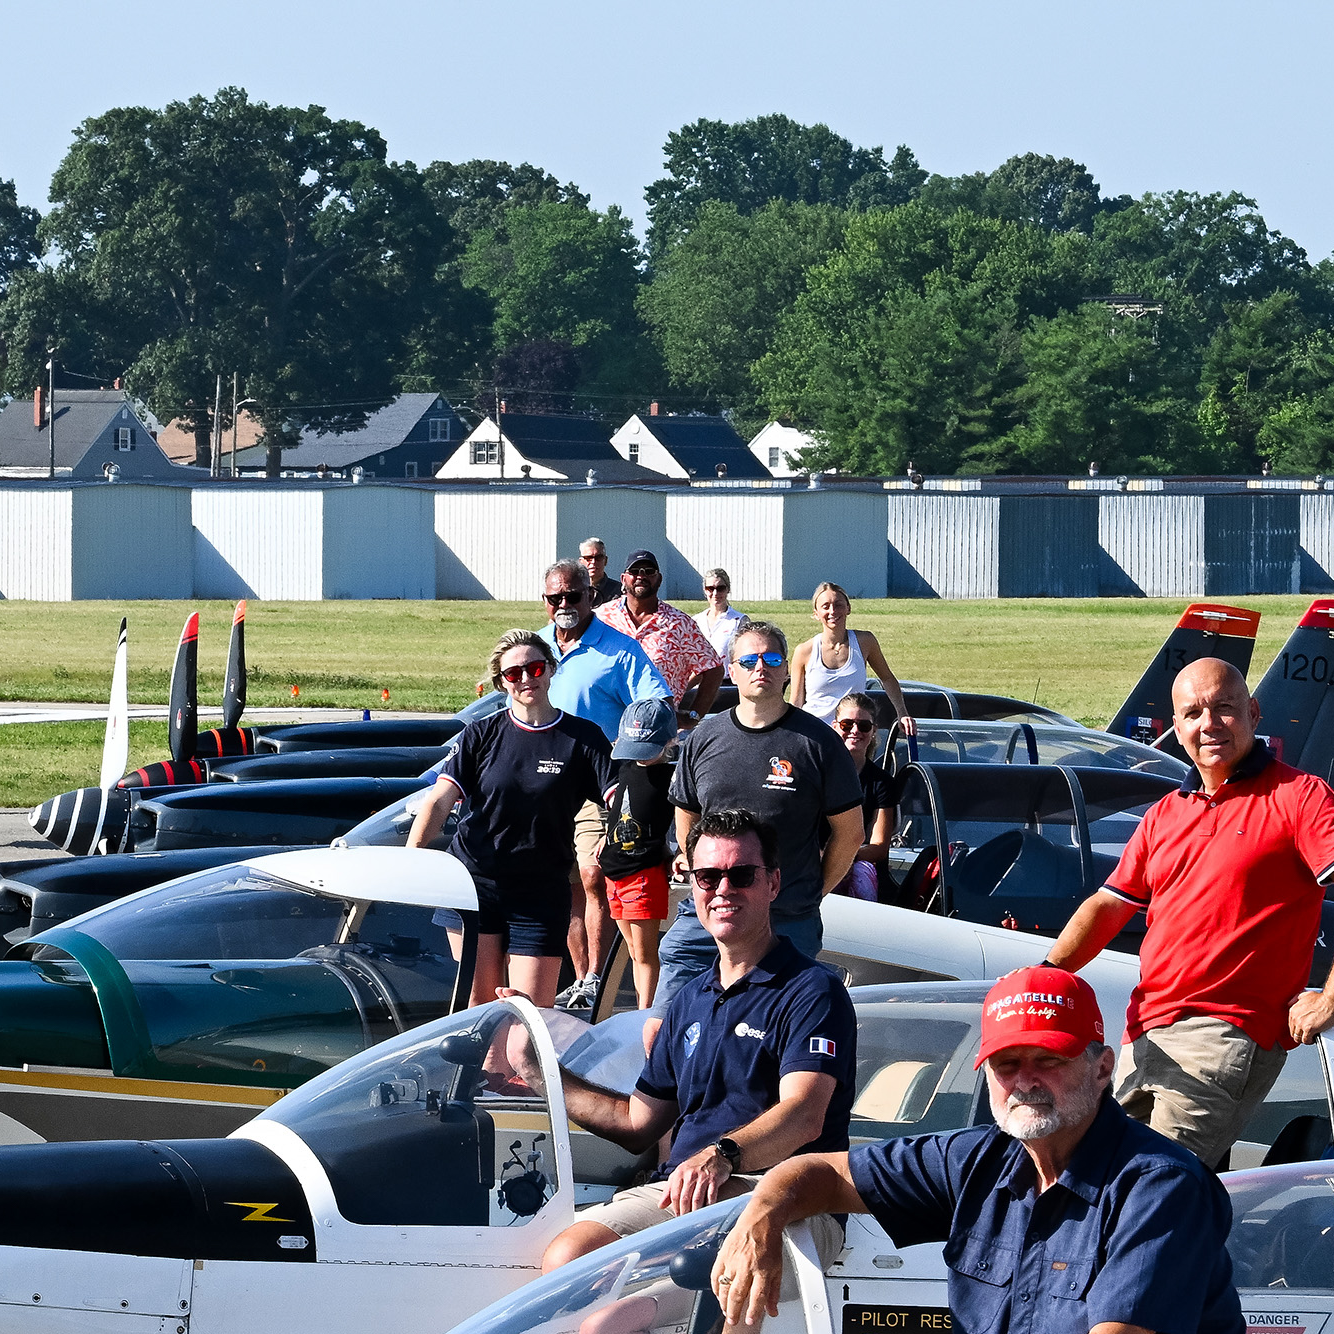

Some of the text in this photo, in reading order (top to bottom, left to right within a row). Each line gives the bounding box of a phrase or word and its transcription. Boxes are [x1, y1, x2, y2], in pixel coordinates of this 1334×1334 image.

[1282, 652, 1328, 683] 120
[861, 1311, 953, 1329] PILOT RES
[1249, 1315, 1300, 1325] DANGER
